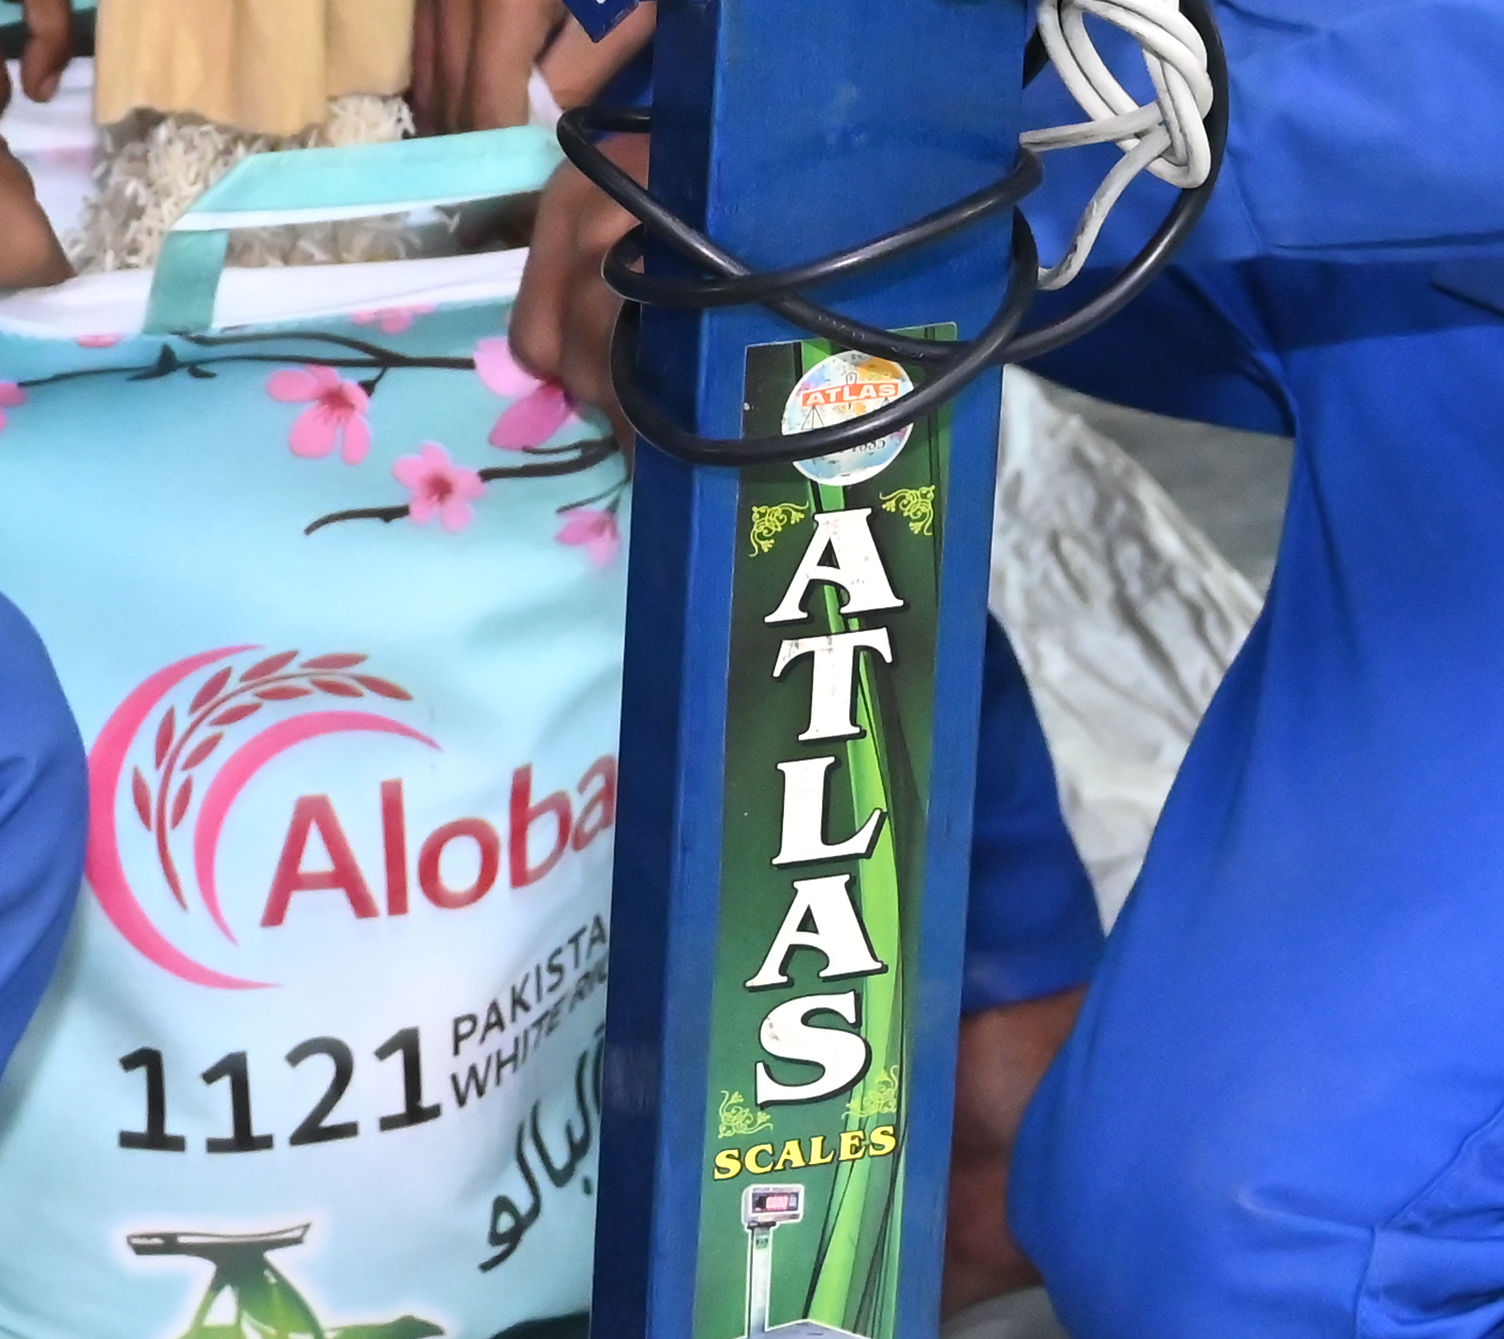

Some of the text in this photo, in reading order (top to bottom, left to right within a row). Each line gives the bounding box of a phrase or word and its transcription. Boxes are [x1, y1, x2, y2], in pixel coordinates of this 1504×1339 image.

[805, 383, 896, 406] ATLAS
[259, 754, 617, 928] Aloba
[744, 507, 904, 1107] ATLAS
[451, 914, 607, 1057] PAKISTA
[118, 1026, 442, 1154] 1121
[450, 995, 566, 1109] WHITE
[713, 1125, 897, 1180] SCALES
